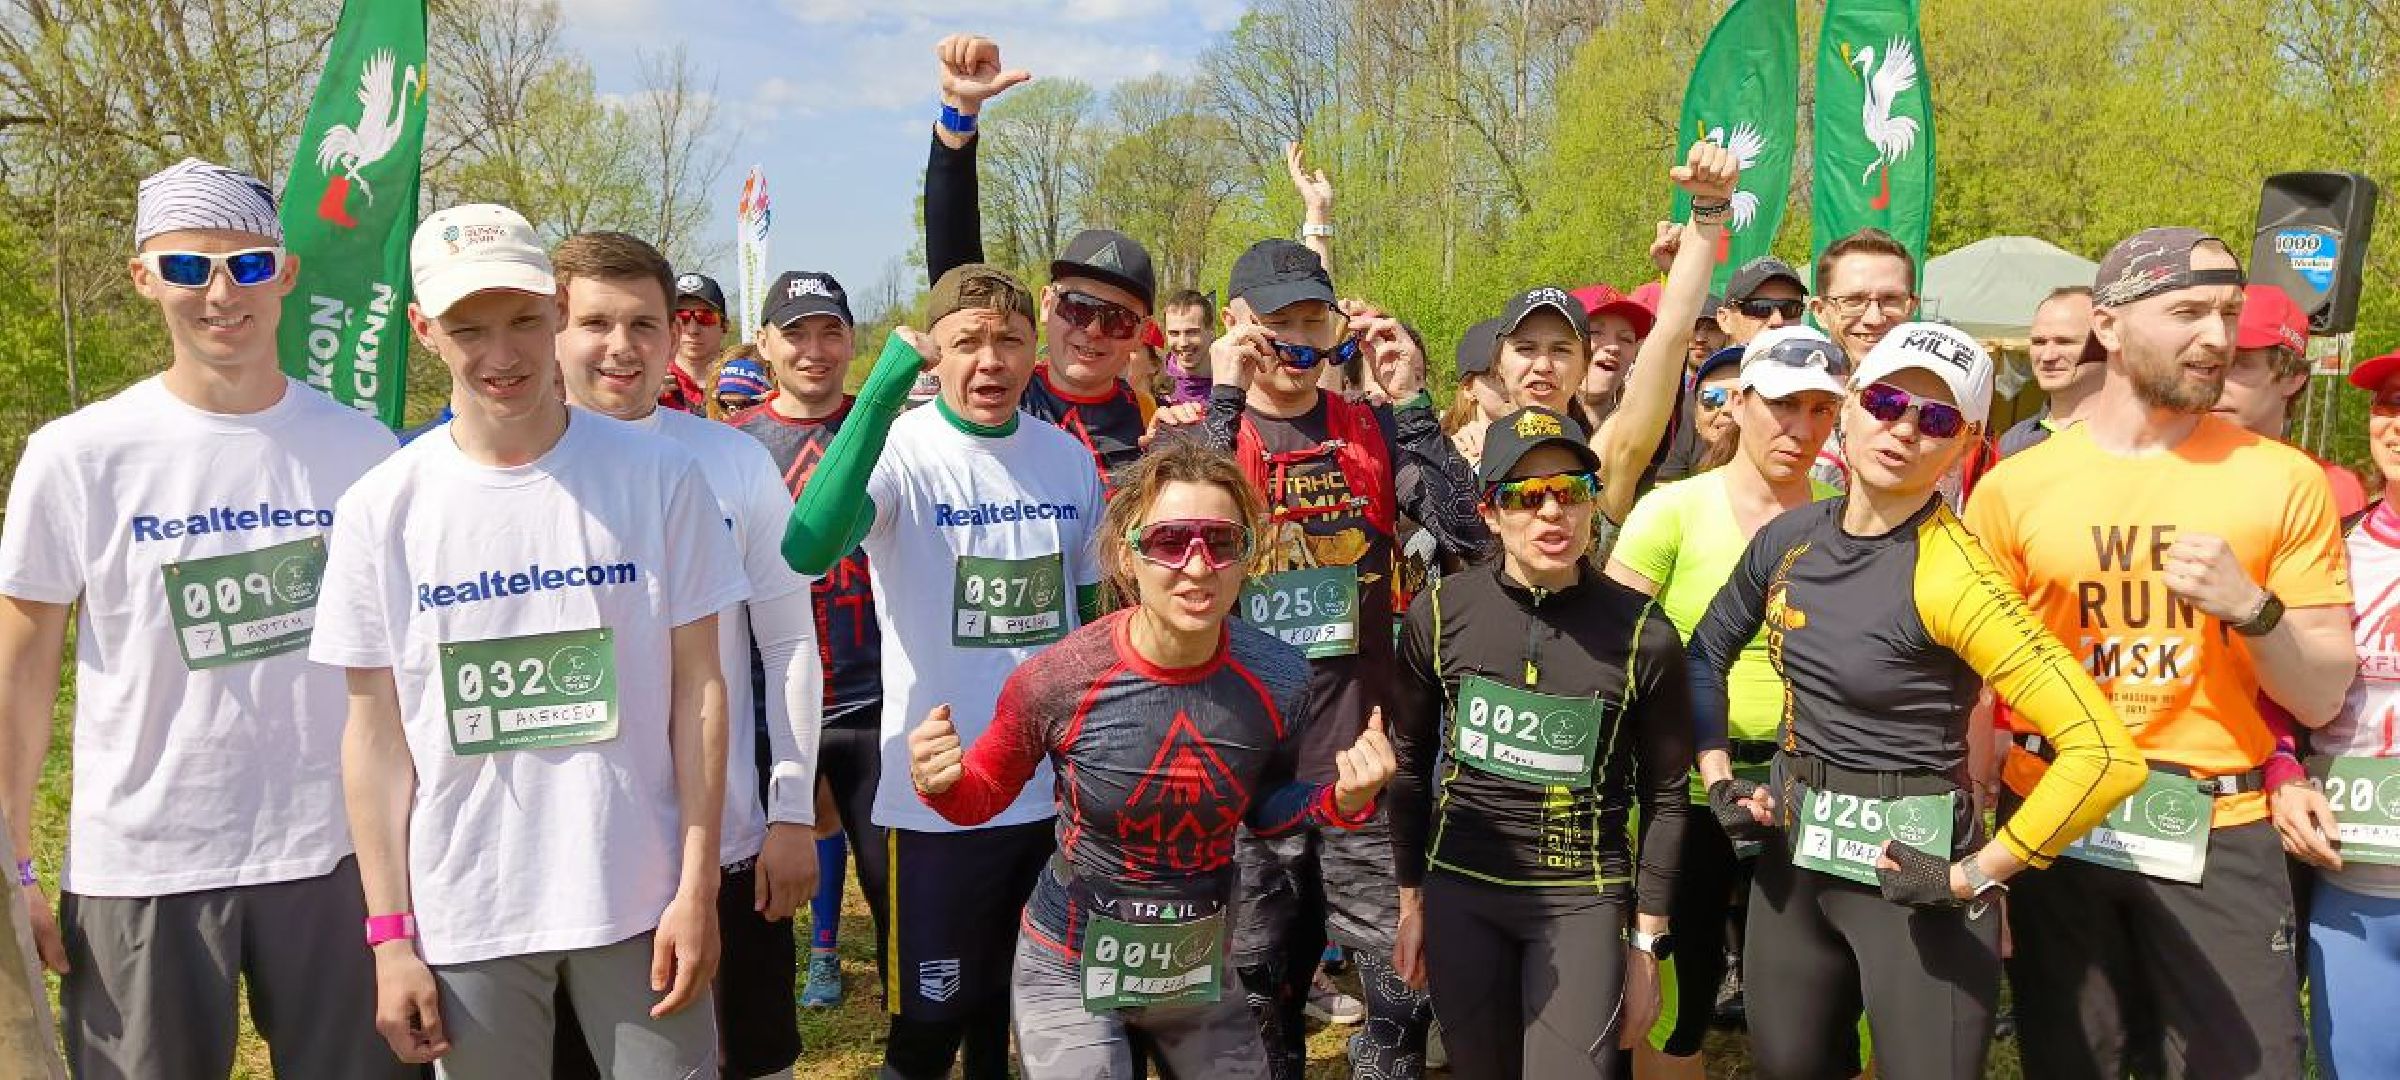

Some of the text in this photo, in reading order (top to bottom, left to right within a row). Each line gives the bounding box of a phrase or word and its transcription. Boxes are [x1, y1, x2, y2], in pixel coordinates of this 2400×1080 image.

[2276, 236, 2321, 254] 1000
[1899, 336, 1976, 379] MILE
[132, 502, 334, 542] Realteleco
[935, 500, 1079, 527] Realtelecom
[2091, 524, 2177, 571] WE
[182, 572, 274, 619] 009
[417, 561, 637, 612] Realtelecom
[964, 574, 1029, 608] 037
[2078, 581, 2195, 629] RUN
[966, 614, 977, 633] 7
[1251, 588, 1313, 623] 025
[195, 629, 216, 650] 7
[2093, 642, 2180, 679] MSK
[458, 657, 548, 702] 032
[465, 713, 482, 736] 7
[1469, 696, 1541, 743] 002
[1115, 805, 1246, 842] MAX
[1814, 790, 1884, 833] 026
[1814, 832, 1828, 852] 7
[1095, 934, 1172, 971] 004
[1097, 972, 1113, 991] 7
